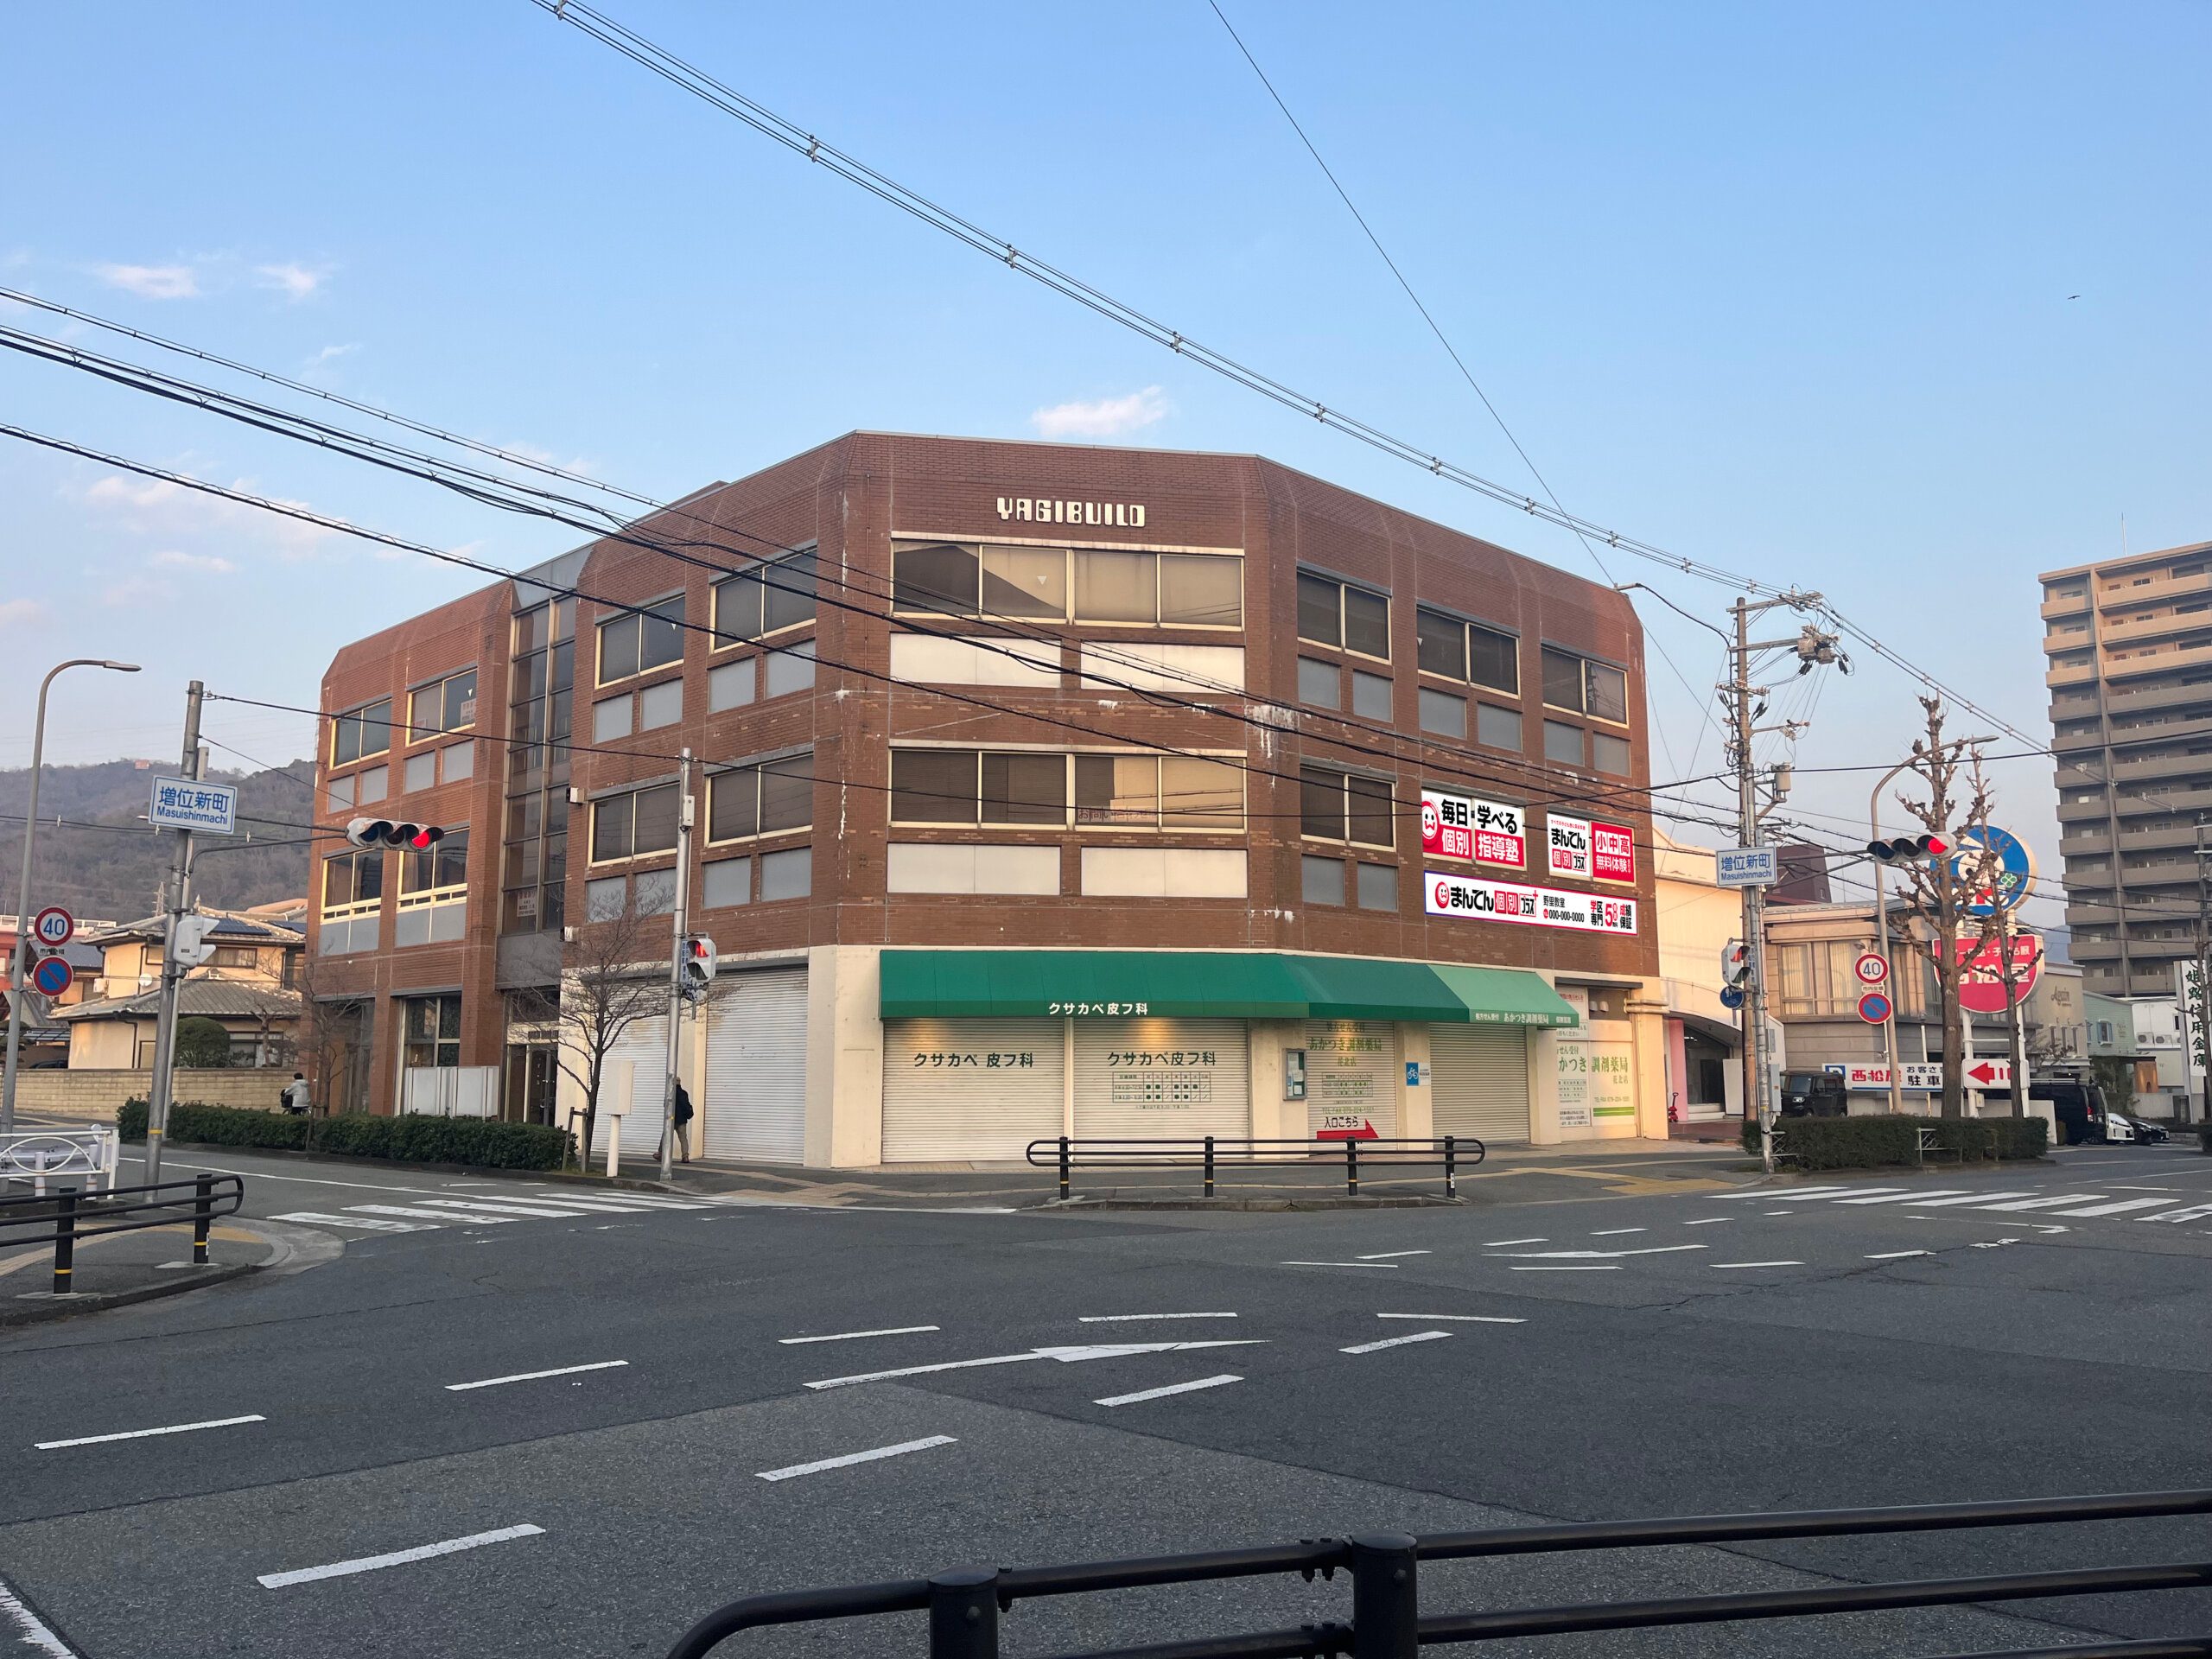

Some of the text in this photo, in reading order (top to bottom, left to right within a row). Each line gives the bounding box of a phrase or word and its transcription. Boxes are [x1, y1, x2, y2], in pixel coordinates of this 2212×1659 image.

[996, 497, 1146, 527] YAGIBUILD
[159, 785, 230, 814] 増位新町
[156, 805, 228, 825] Masuishinmachi
[1440, 798, 1468, 827] 毎日
[1477, 804, 1518, 835] 学べる
[1441, 828, 1520, 862] 個別 指導塾
[1551, 828, 1586, 850] まんてん
[1597, 833, 1630, 855] 小中高
[1595, 855, 1628, 874] 無料体験
[1720, 853, 1771, 872] 増位新町
[1720, 869, 1772, 880] Masuishinmachi
[1543, 895, 1566, 908] 野里教室
[1590, 899, 1604, 913] 学区
[1549, 909, 1585, 923] 000-000-0000
[1590, 912, 1604, 926] 専門
[43, 918, 66, 936] 40
[1863, 962, 1881, 976] 40
[1048, 1002, 1148, 1015] クサカベ皮フ科
[1309, 1037, 1382, 1052] あかつき調剤薬局
[1107, 1051, 1216, 1066] クサカベ皮フ科
[1324, 1116, 1359, 1128] 入口こちら
